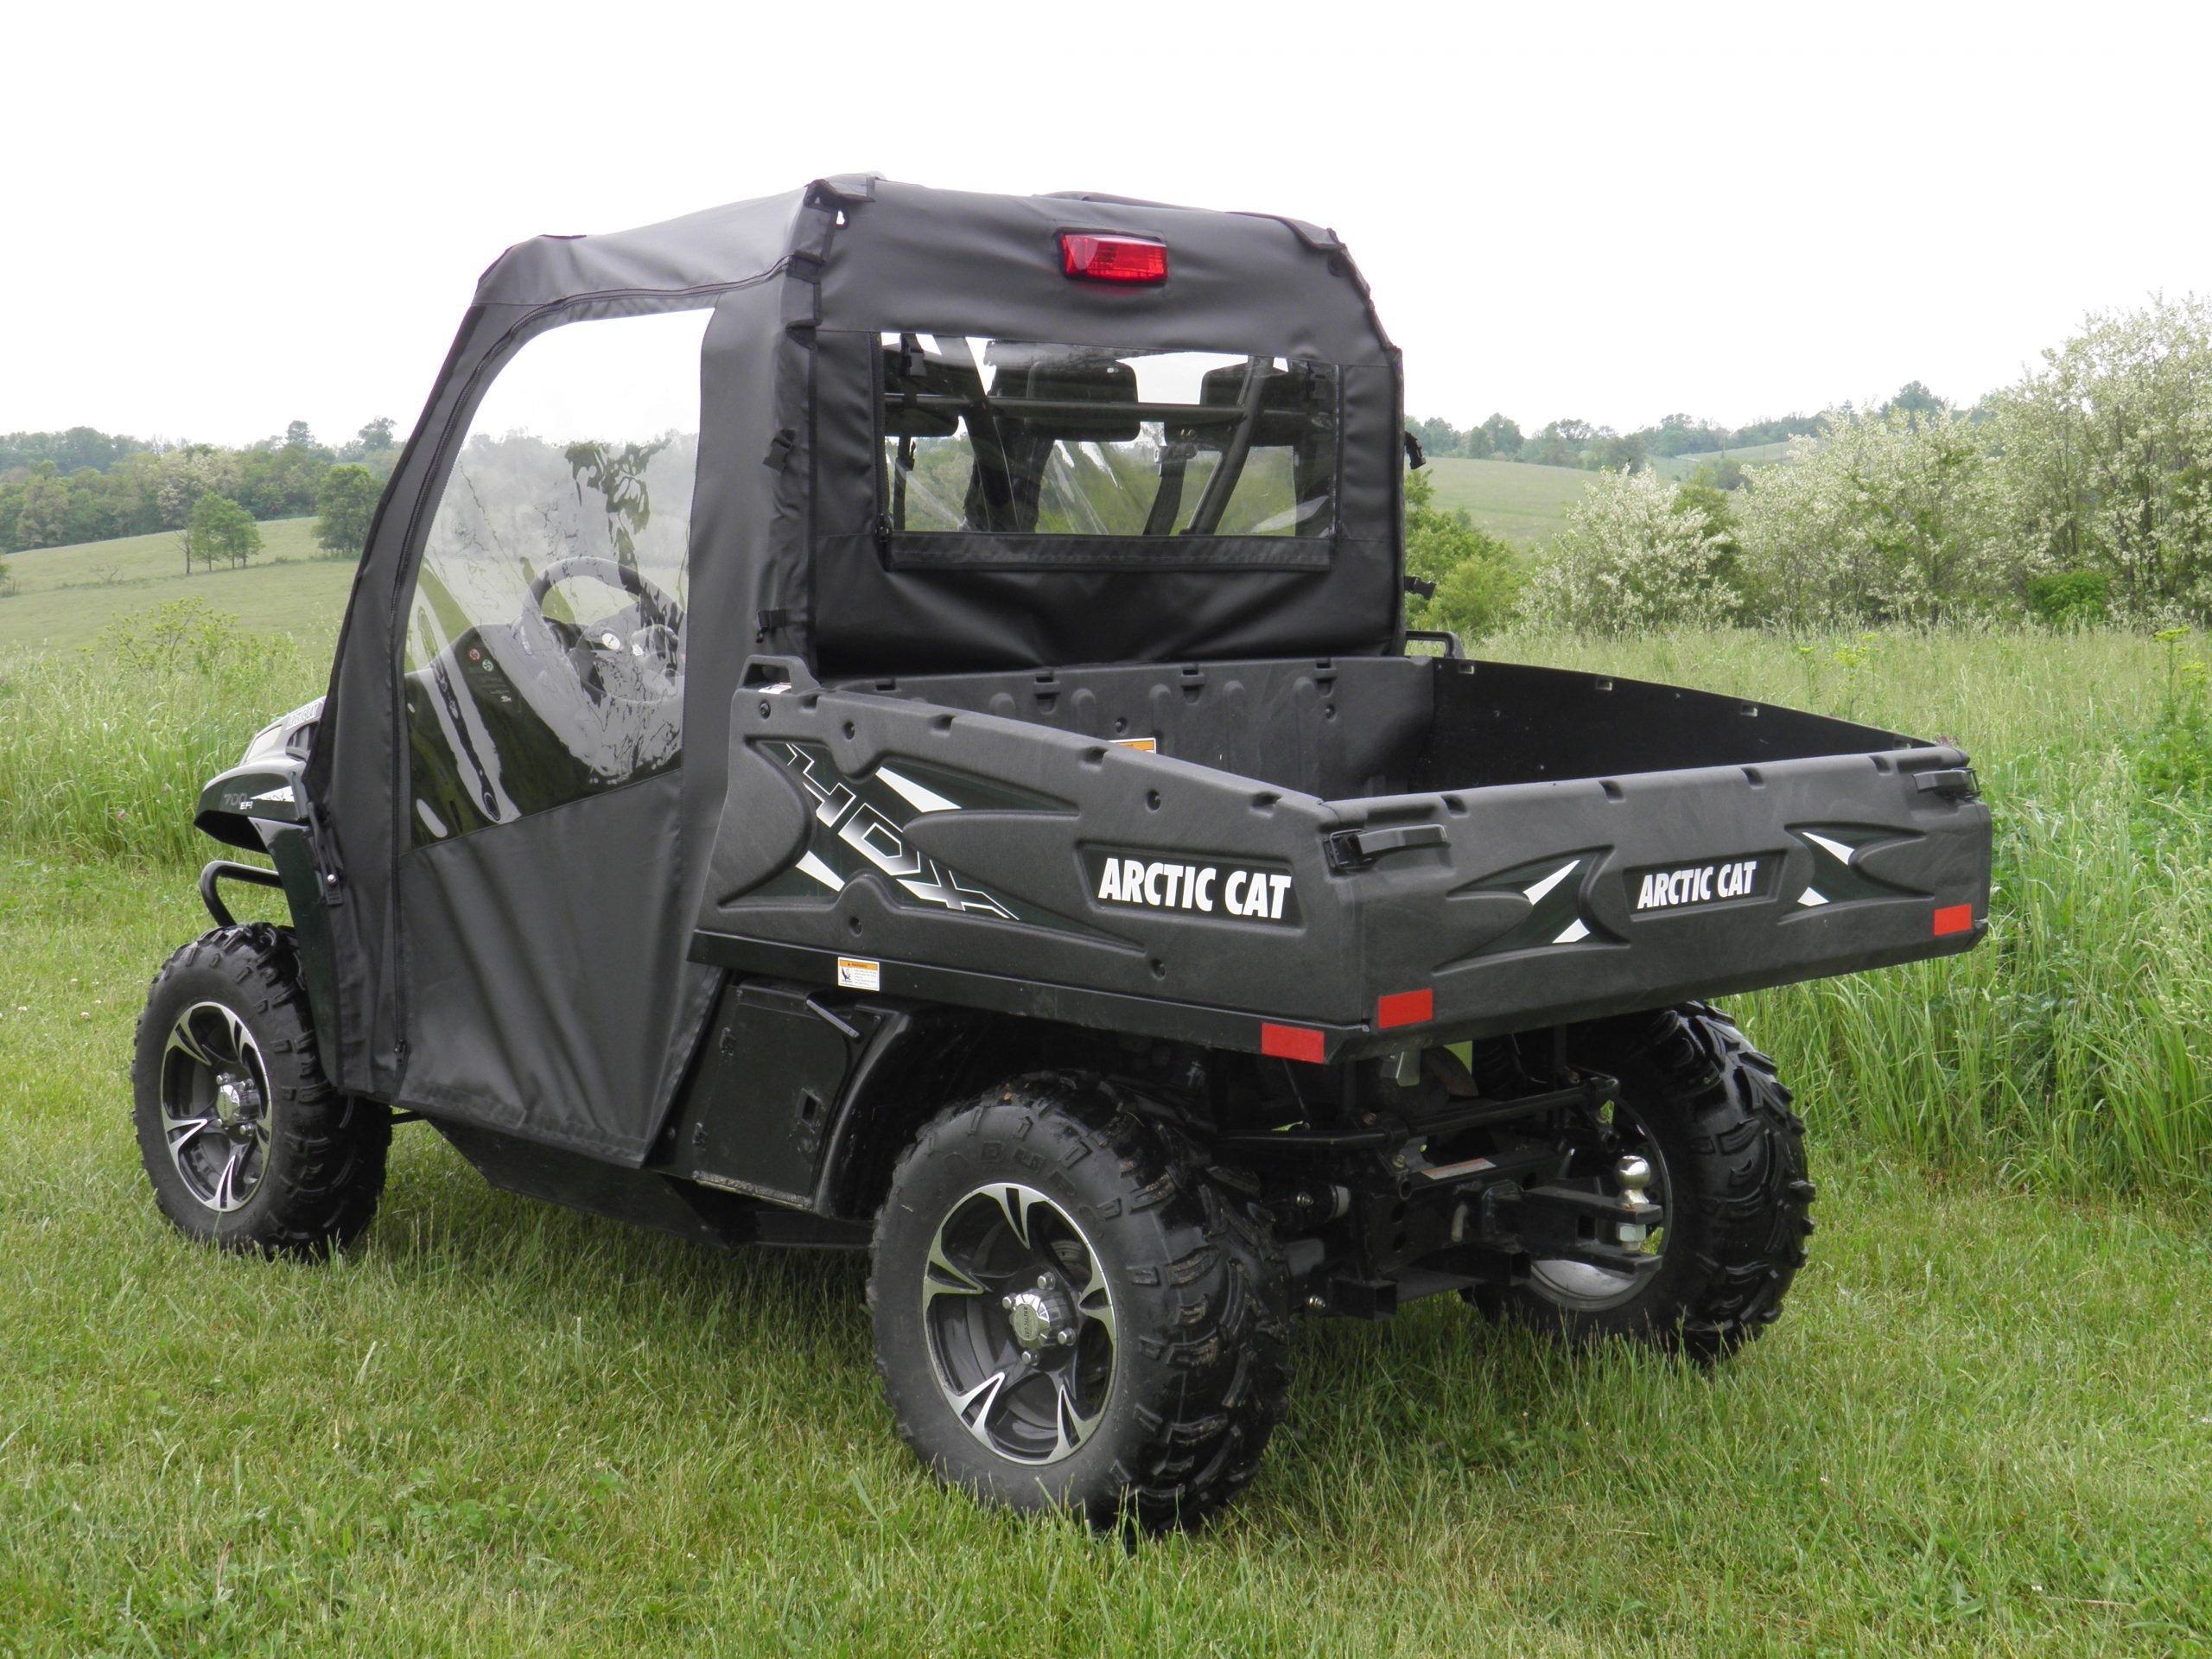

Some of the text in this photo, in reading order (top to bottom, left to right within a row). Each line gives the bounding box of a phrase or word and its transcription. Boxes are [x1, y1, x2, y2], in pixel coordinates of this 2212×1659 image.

[1097, 857, 1292, 919] ARCTIC CAT
[1637, 861, 1758, 910] ARCTIC CAT
